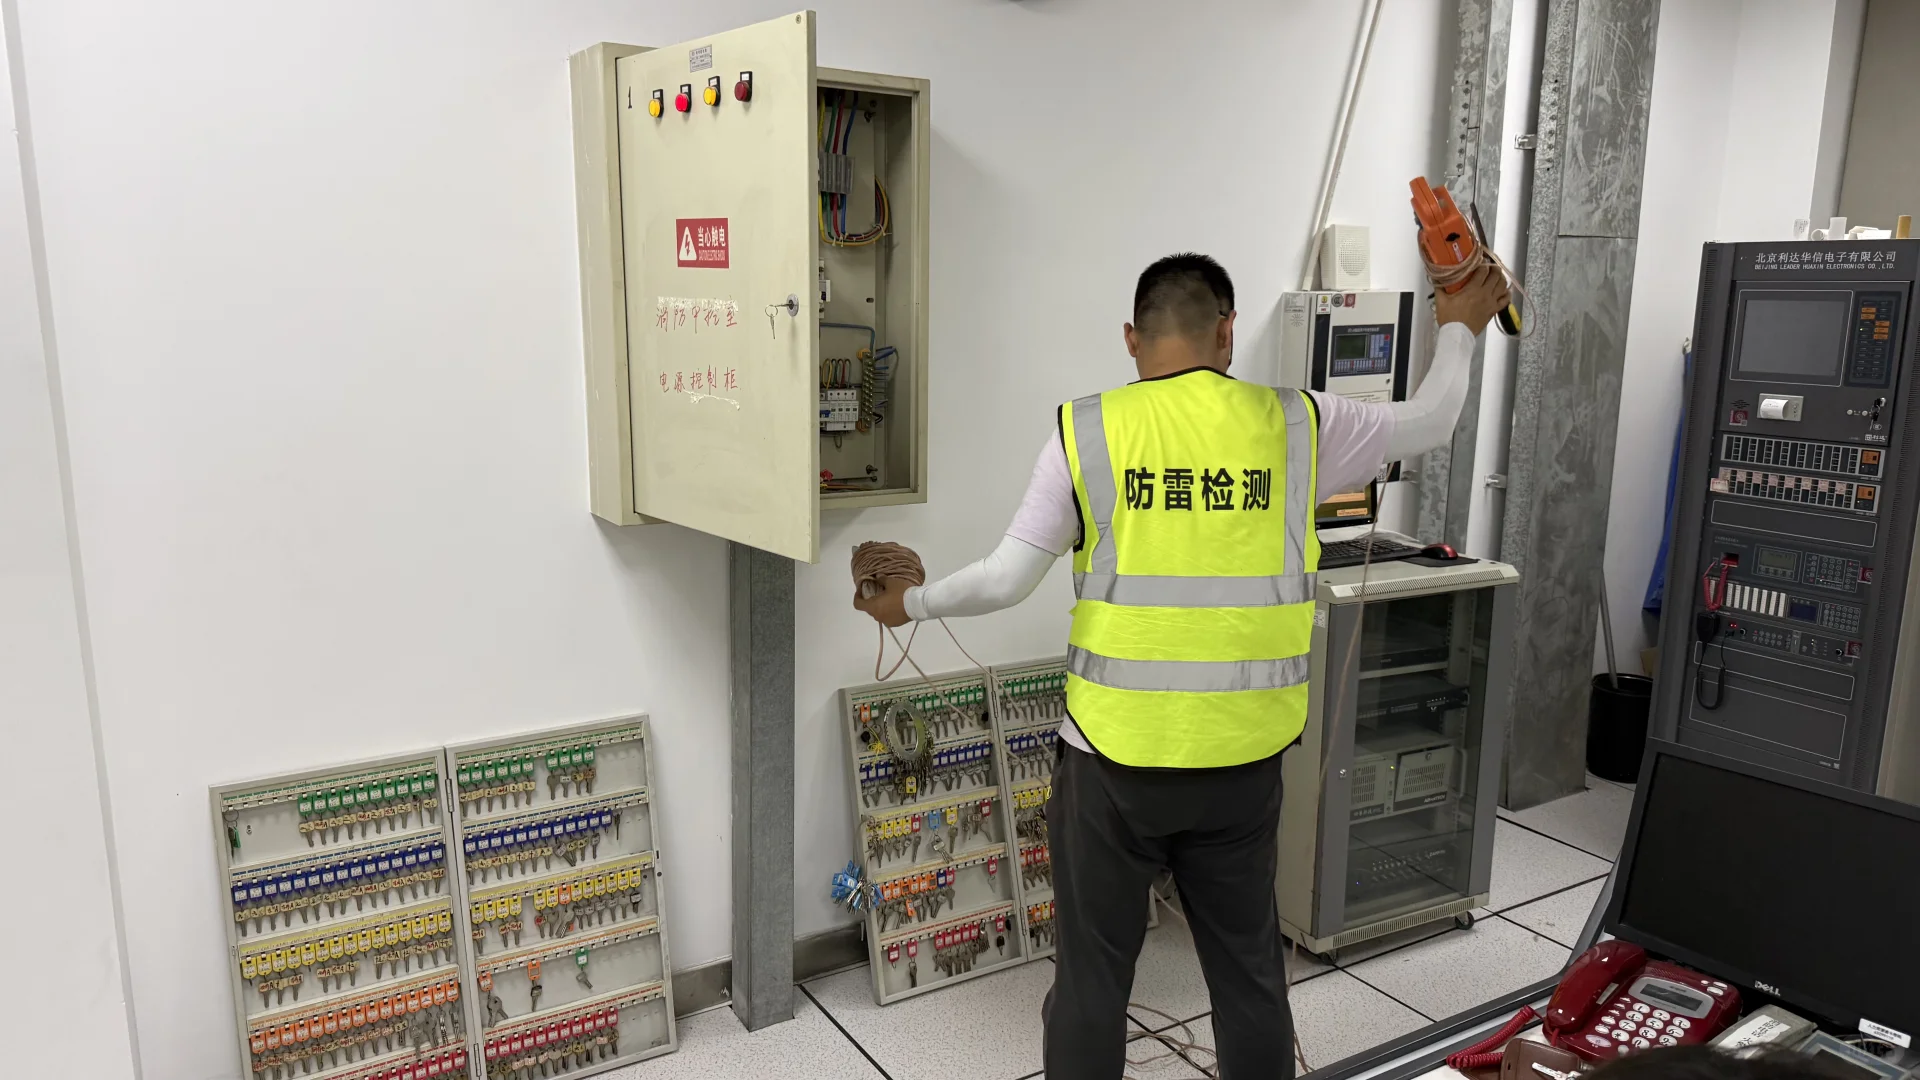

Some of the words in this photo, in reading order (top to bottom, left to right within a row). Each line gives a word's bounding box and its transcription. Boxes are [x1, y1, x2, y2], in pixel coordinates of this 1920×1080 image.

[697, 225, 726, 247] 当心触电
[1755, 251, 1897, 263] 北京利达华信电子有限公司
[1125, 467, 1271, 511] 防雷检测
[1755, 980, 1780, 996] DELL
